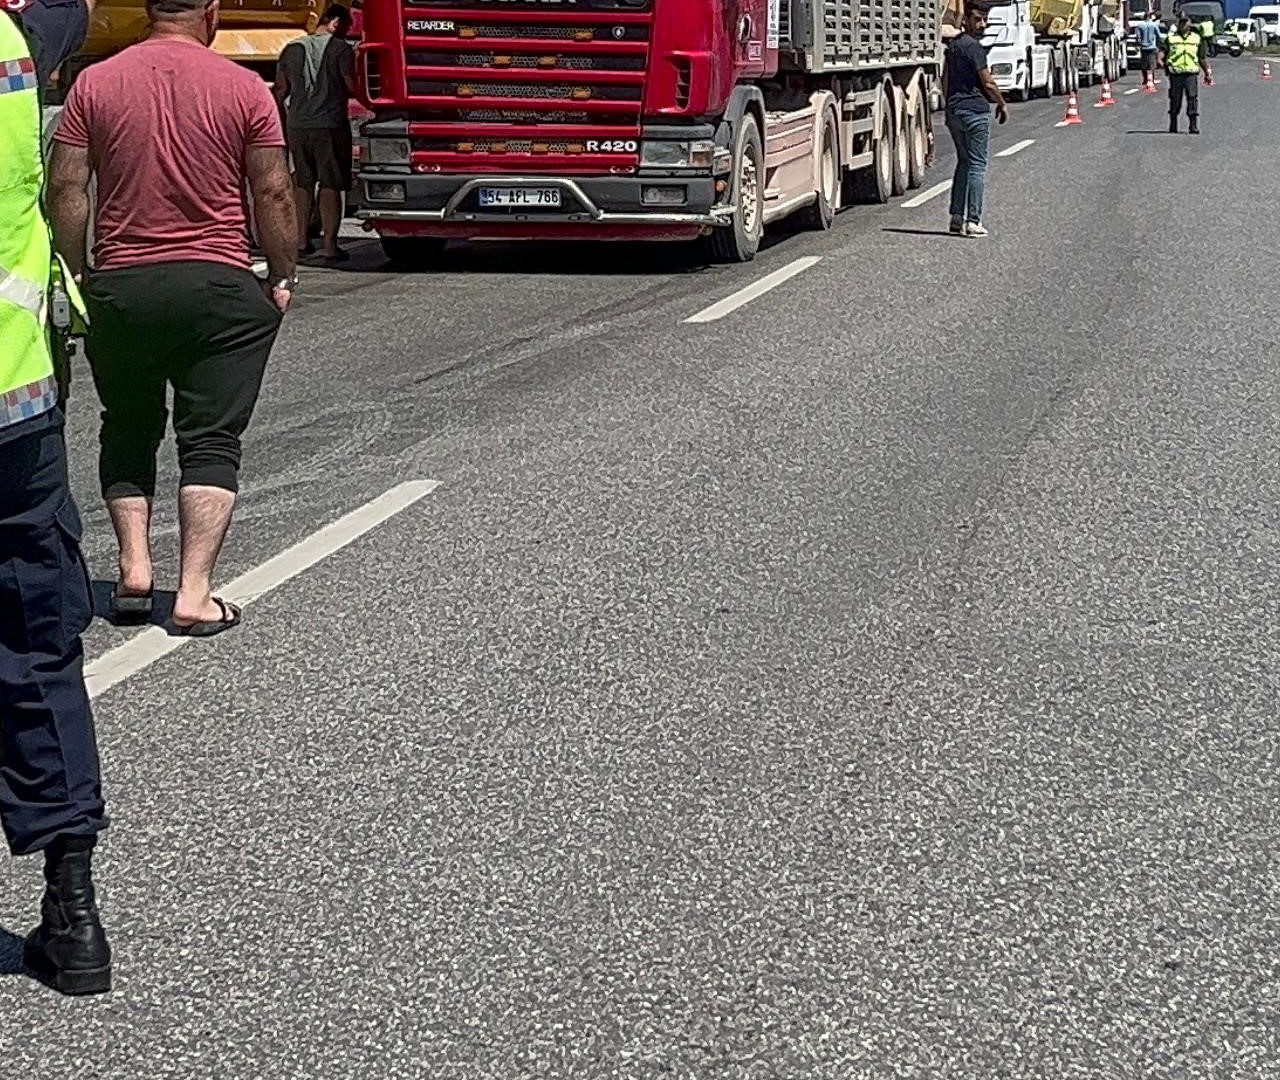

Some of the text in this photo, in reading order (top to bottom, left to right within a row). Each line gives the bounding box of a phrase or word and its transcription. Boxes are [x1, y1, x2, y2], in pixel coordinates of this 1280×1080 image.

[407, 20, 456, 31] RETARDER
[487, 190, 559, 204] 54 AFL 766
